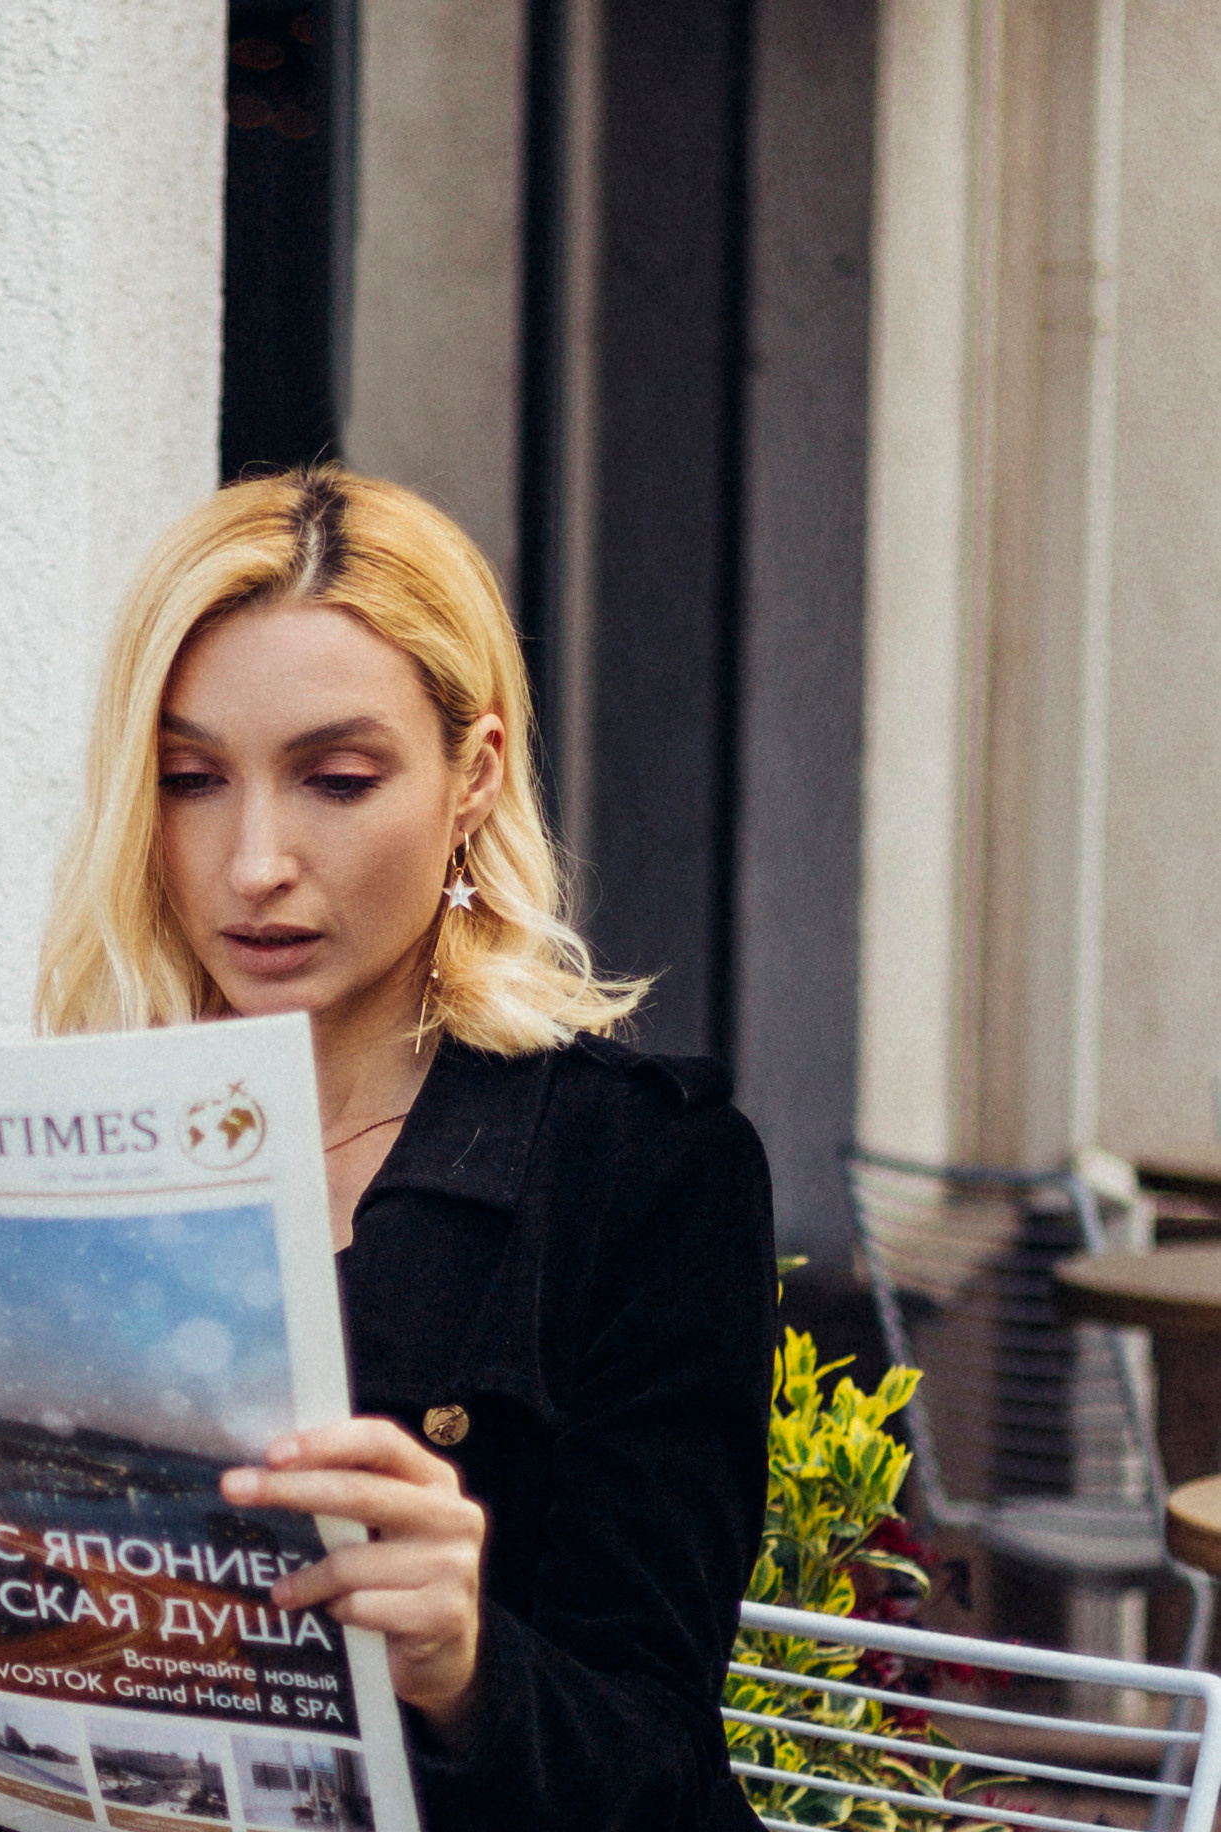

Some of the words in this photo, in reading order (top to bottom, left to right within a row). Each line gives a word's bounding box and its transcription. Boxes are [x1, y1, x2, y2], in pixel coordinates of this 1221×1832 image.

[161, 1598, 333, 1651] ДУША
[123, 1648, 257, 1682] Встречайте
[265, 1670, 338, 1692] новый
[114, 1676, 187, 1704] Grand
[195, 1686, 262, 1712] Hotel
[270, 1694, 288, 1715] &
[296, 1698, 343, 1723] SPA
